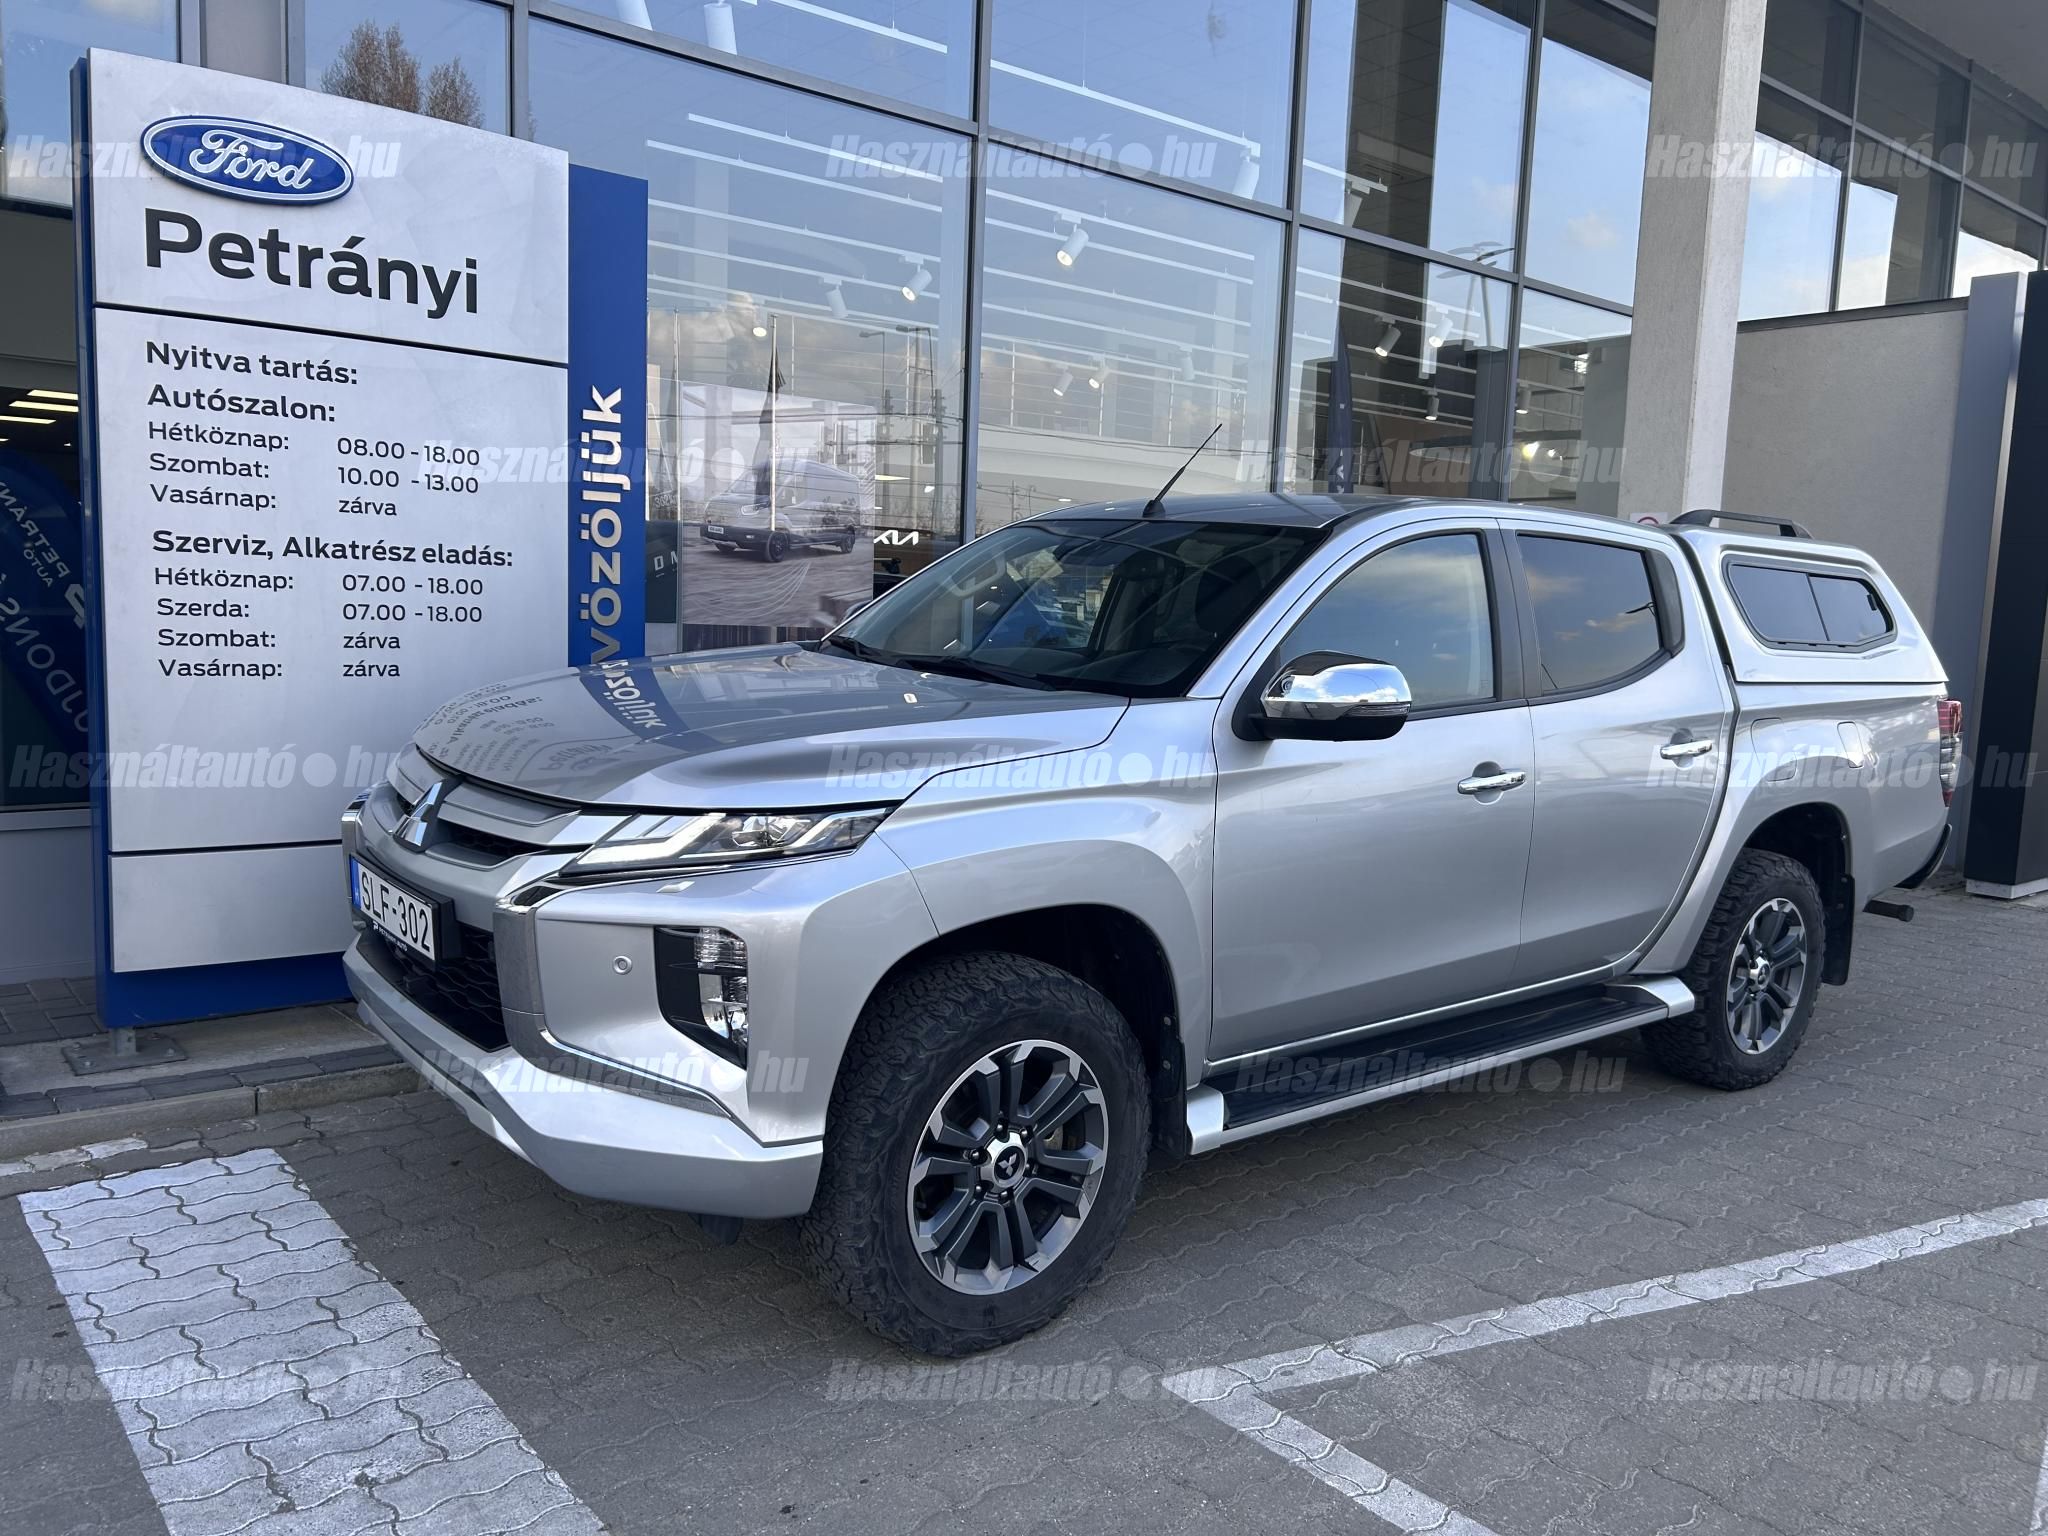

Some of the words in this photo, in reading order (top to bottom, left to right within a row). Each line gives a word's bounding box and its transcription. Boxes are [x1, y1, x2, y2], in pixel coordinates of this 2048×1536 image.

[189, 128, 313, 190] Ford
[145, 207, 478, 319] Petrányi
[146, 341, 252, 374] Nyitva
[258, 354, 357, 385] tartás:
[147, 384, 335, 422] Autószalon:
[148, 421, 289, 452] Hétköznap:
[337, 437, 405, 460] 08.00
[149, 452, 269, 479] Szombat:
[337, 466, 400, 488] 10.00
[149, 483, 276, 512] Vasárnap:
[338, 496, 397, 516] zárva
[152, 530, 274, 561] Szerviz,
[282, 536, 417, 563] Alkatrész
[422, 543, 513, 567] eladás:
[155, 567, 294, 593] Hétköznap:
[342, 574, 406, 593] 07.00
[157, 597, 250, 618] Szerda:
[342, 603, 406, 621] 07.00
[157, 628, 276, 648] Szombat:
[343, 631, 401, 649] zárva
[158, 658, 282, 680] Vasárnap:
[342, 659, 401, 677] zárva
[361, 871, 430, 952] SLF-302
